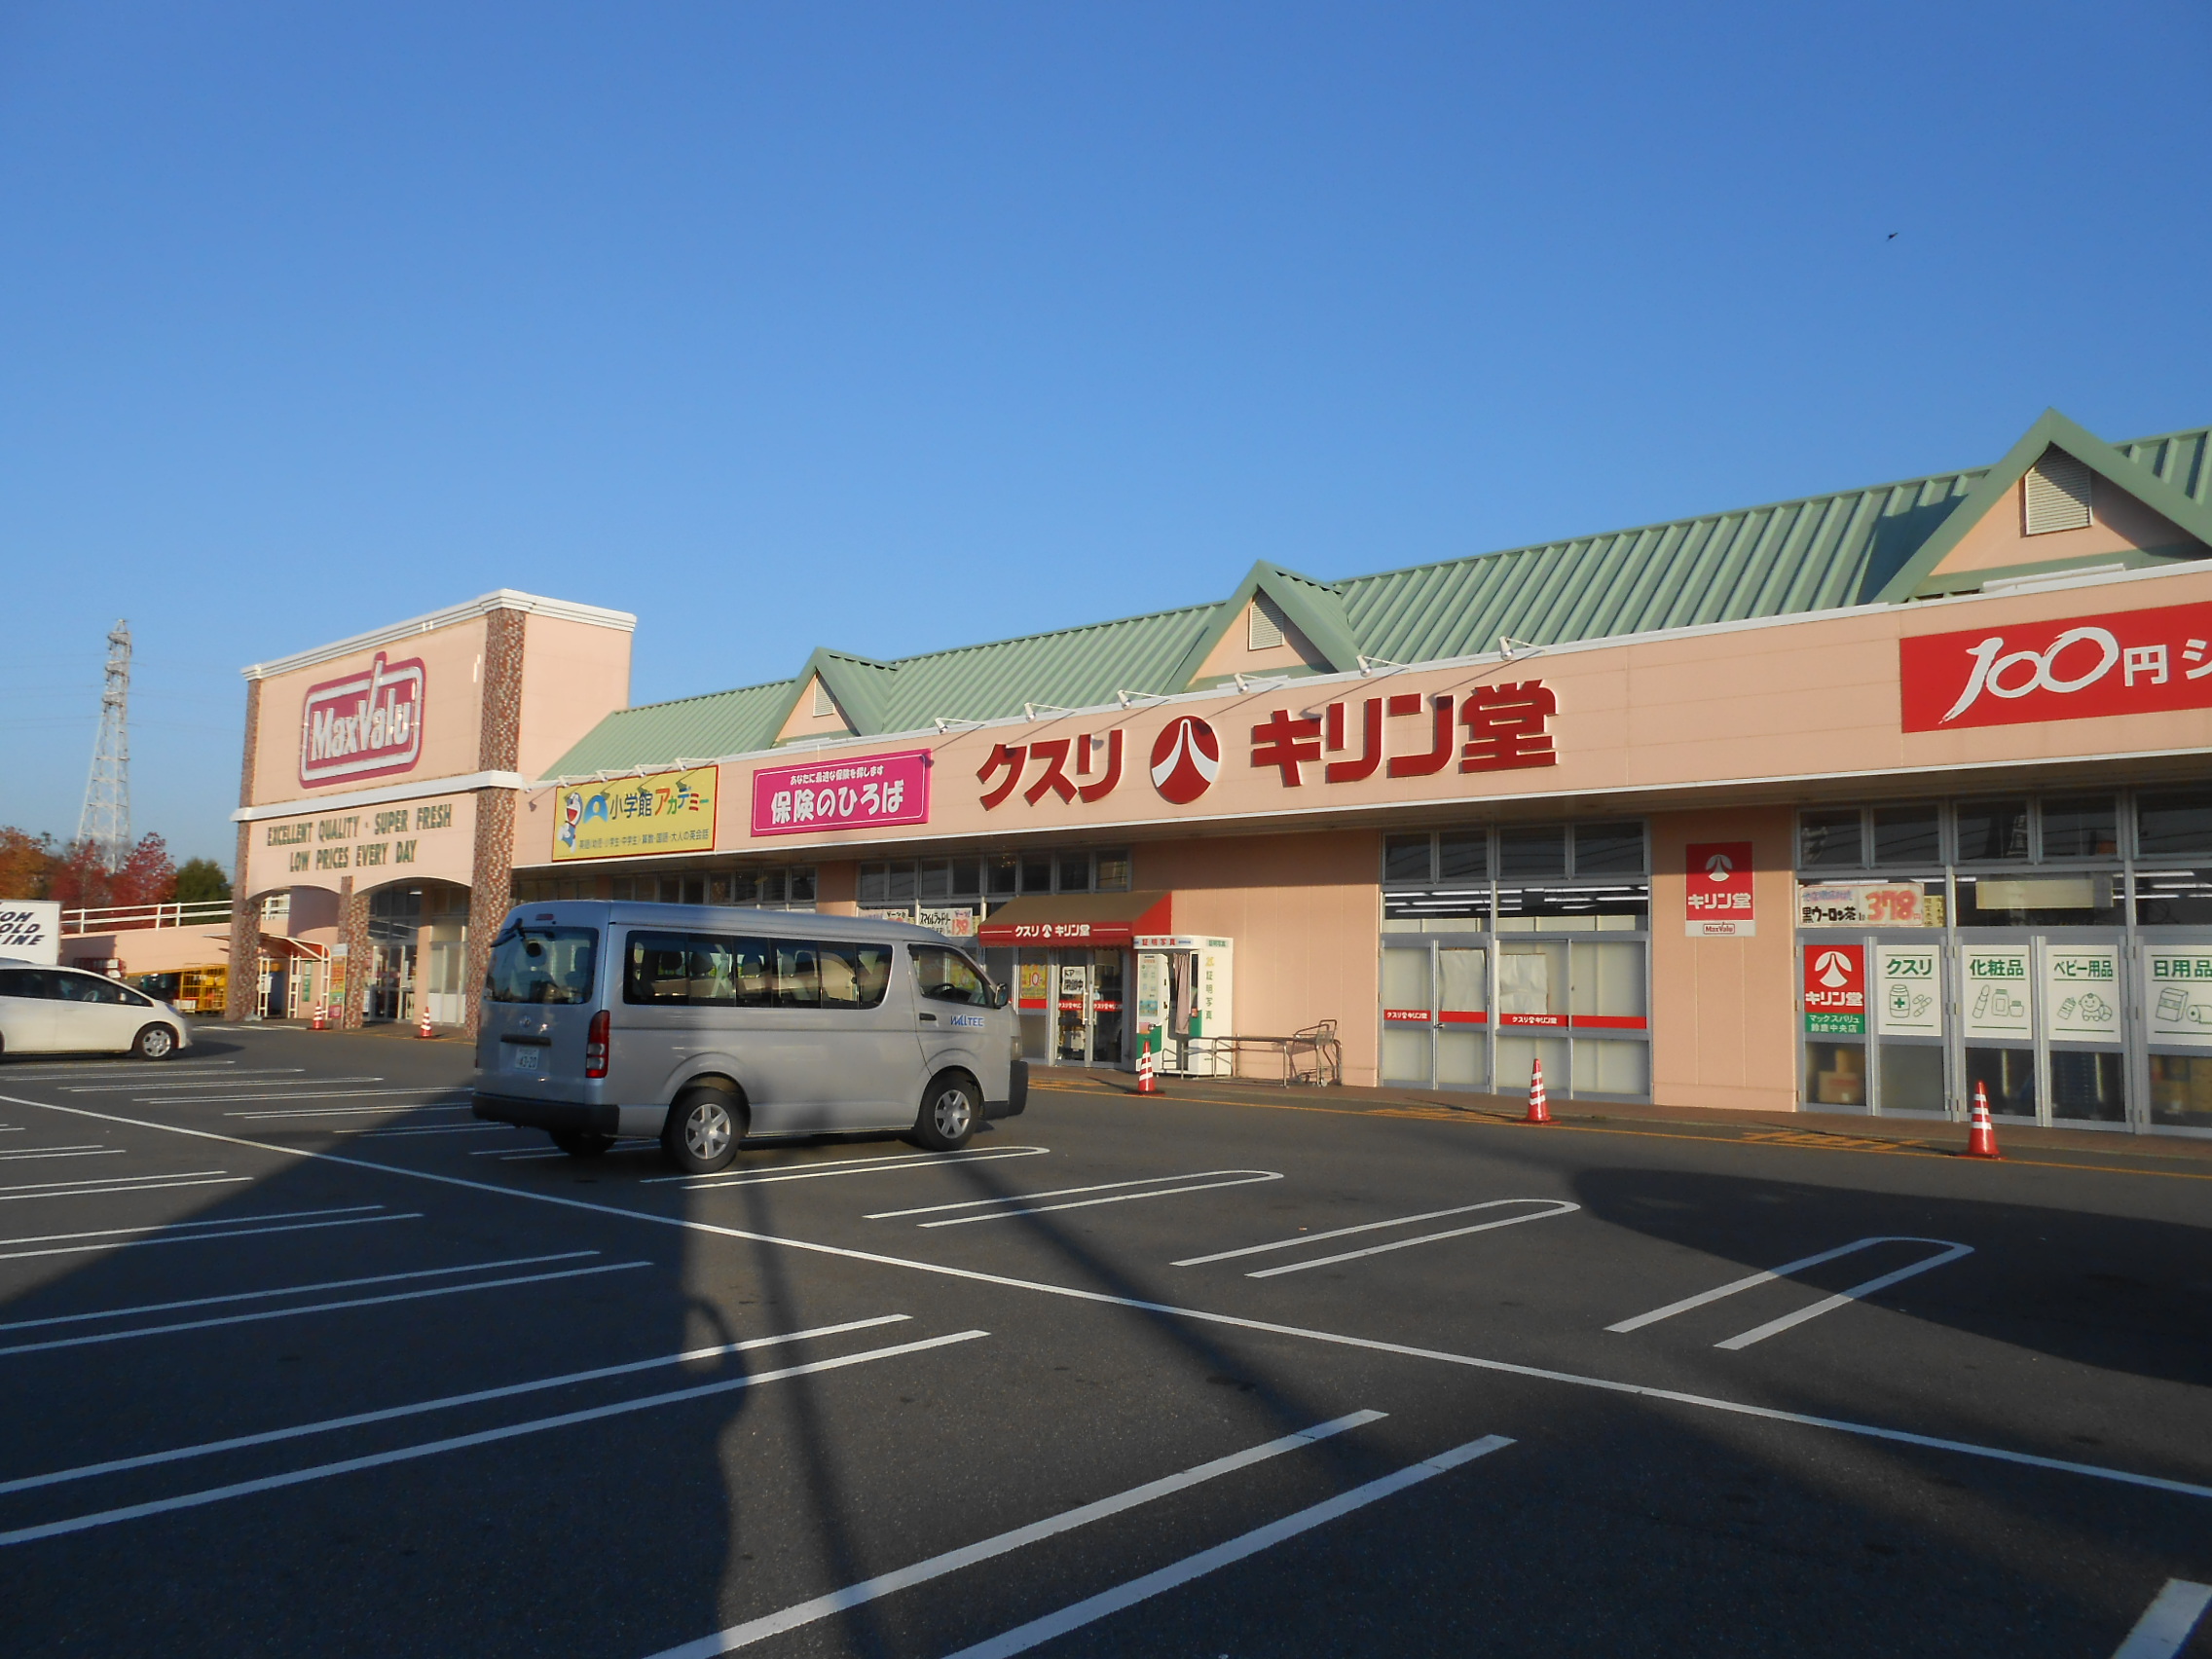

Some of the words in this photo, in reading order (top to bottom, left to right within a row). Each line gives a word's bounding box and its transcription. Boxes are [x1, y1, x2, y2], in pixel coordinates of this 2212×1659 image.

[312, 660, 411, 761] MaxValu
[976, 728, 1124, 812] クスリ
[1251, 679, 1559, 788] キリン堂
[770, 779, 904, 825] 保険のひろば
[268, 822, 313, 847] EXCELLENT
[318, 816, 360, 842] QUALITY
[375, 809, 409, 834] SUPER
[417, 804, 453, 830] FRESH
[290, 851, 311, 872] LOW
[316, 847, 349, 870] PRICES
[356, 843, 388, 866] EVERY
[396, 839, 418, 863] DAY
[1687, 892, 1751, 909] キリン堂
[0, 911, 34, 922] OH
[1802, 906, 1857, 923] 黒ウーロン茶
[1014, 925, 1039, 938] クスリ
[1055, 924, 1090, 937] キリン堂
[0, 935, 45, 945] INE
[1886, 958, 1933, 976] クスリ
[1970, 959, 2024, 977] 化粧品
[2053, 960, 2113, 977] ベビー用品
[2154, 960, 2212, 978] 日用品
[1805, 991, 1863, 1006] キリン堂
[1809, 1014, 1860, 1023] マックスバリュ
